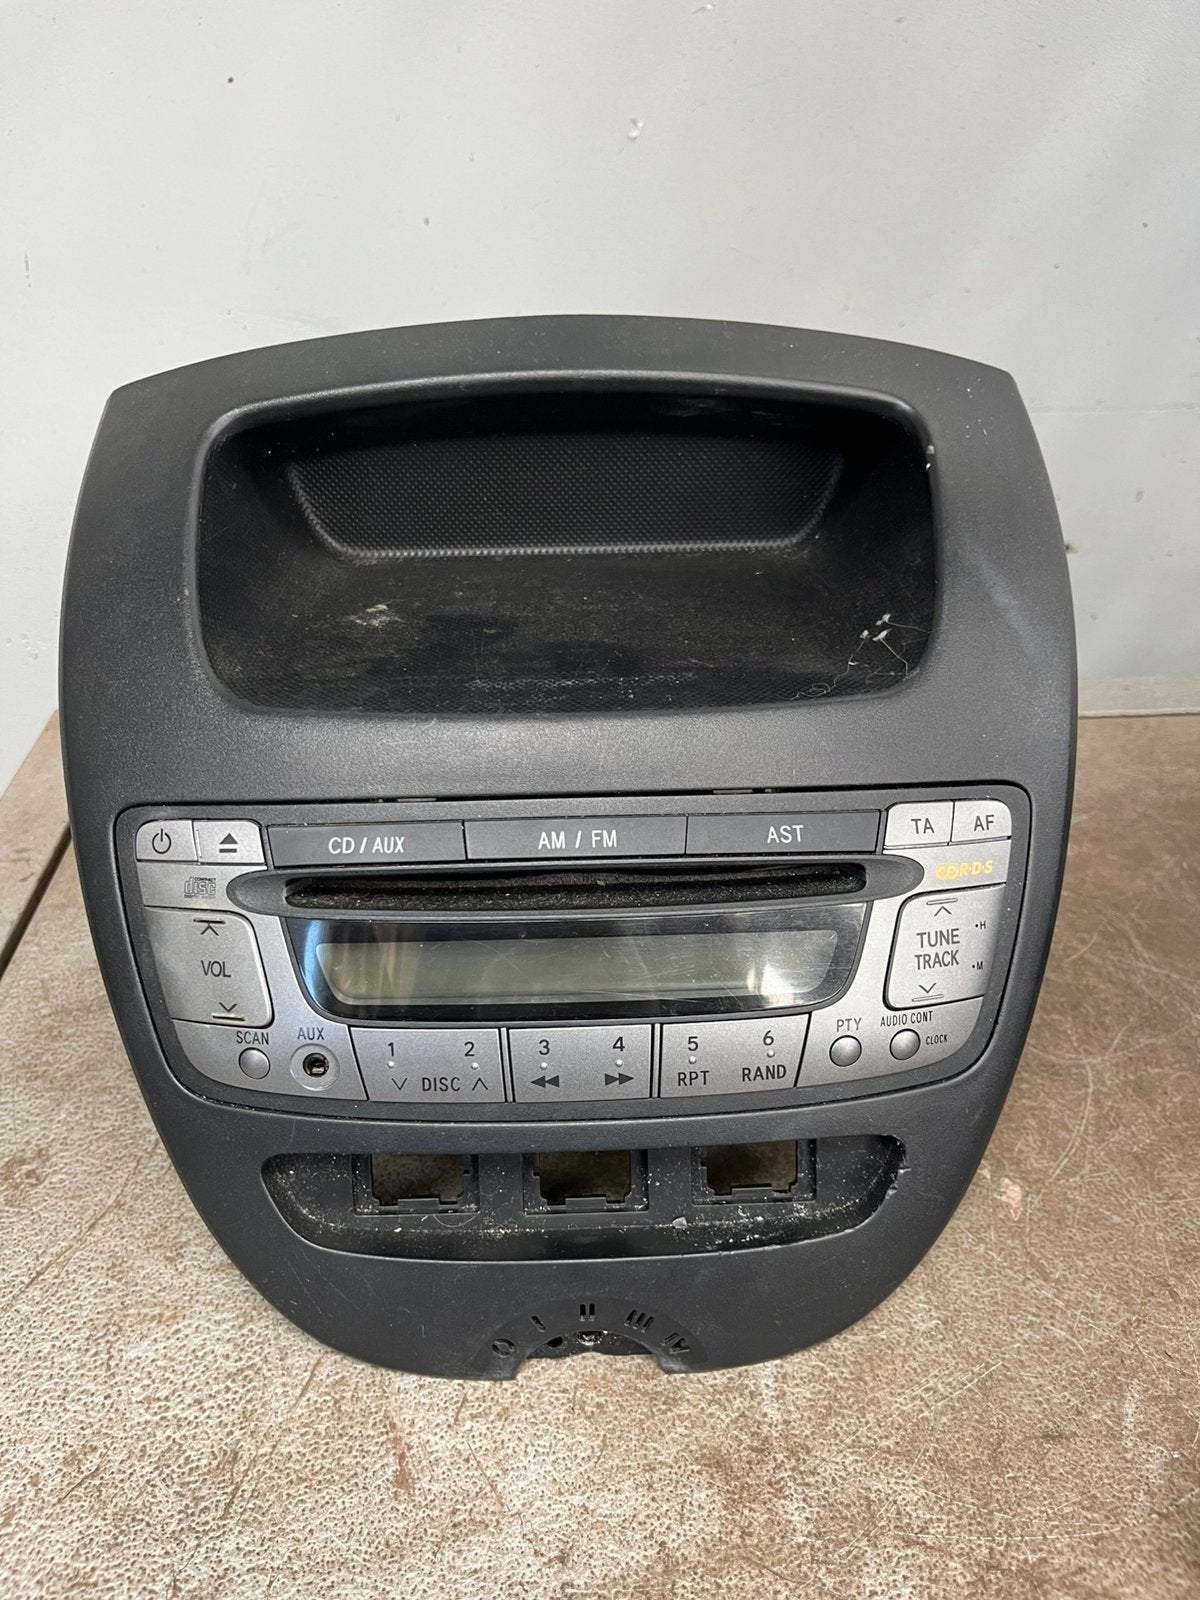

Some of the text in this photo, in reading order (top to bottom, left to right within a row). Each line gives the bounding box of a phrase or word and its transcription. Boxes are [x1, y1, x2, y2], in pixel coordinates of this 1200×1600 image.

[910, 817, 935, 834] TA
[973, 814, 995, 832] AF
[538, 830, 618, 850] AM / FM
[766, 825, 804, 843] AST
[328, 837, 355, 854] CD
[371, 836, 405, 853] AUX
[916, 928, 960, 948] TUNE
[914, 949, 960, 970] TRACK
[200, 960, 232, 978] VOL
[836, 1017, 862, 1032] PTY
[880, 1010, 933, 1027] AUDIO CONT
[236, 1031, 270, 1046] SCAN
[297, 1027, 325, 1041] AUX
[762, 1030, 774, 1046] 6
[925, 1034, 948, 1045] CLOCK
[387, 1042, 395, 1057] 1
[464, 1042, 475, 1057] 2
[538, 1039, 550, 1056] 3
[612, 1036, 625, 1052] 4
[687, 1036, 699, 1051] 5
[677, 1070, 709, 1088] RPT
[741, 1064, 787, 1083] RAND
[421, 1076, 461, 1092] DISC
